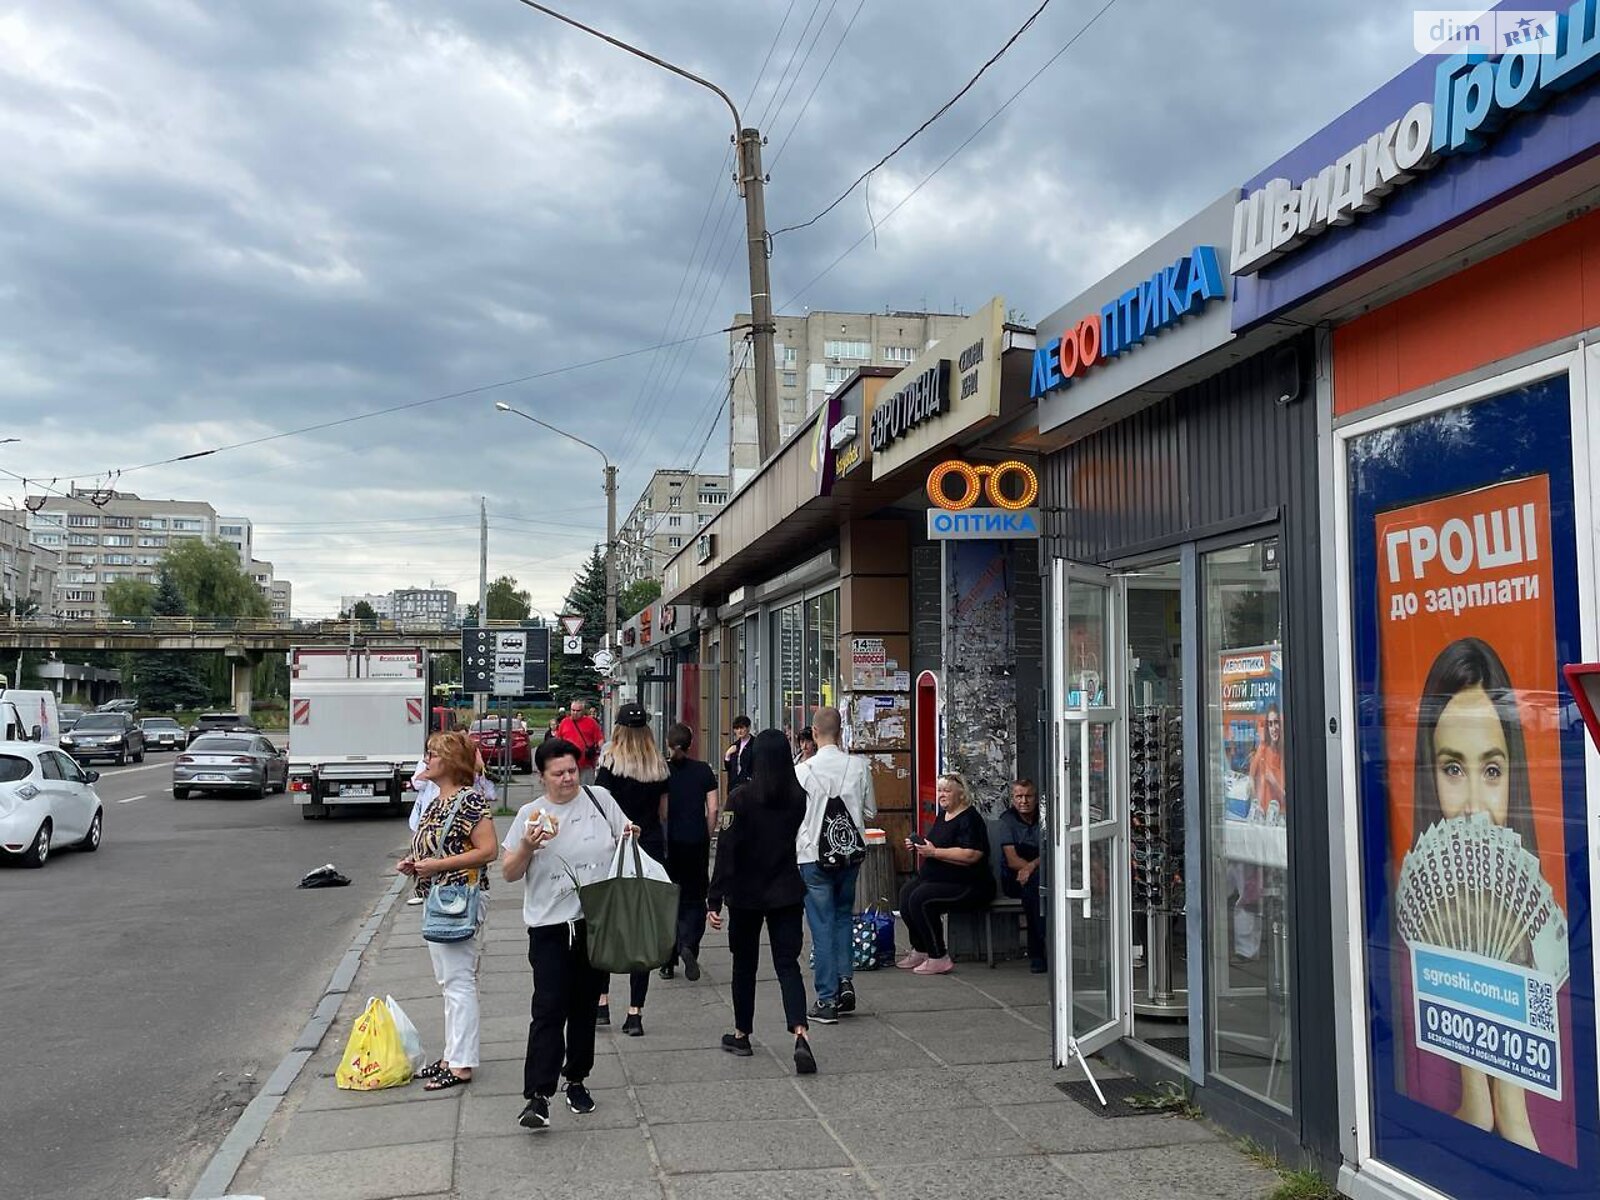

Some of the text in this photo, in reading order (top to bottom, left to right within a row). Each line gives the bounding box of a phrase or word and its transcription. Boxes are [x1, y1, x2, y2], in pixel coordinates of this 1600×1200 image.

[934, 514, 1037, 533] ОПТИКА
[1386, 503, 1539, 583] ГРОШІ
[1390, 574, 1540, 621] до зарплати
[854, 640, 868, 649] 14
[1529, 904, 1550, 940] 1000
[1423, 968, 1520, 1006] sgroshi.com.ua
[1427, 1006, 1550, 1070] 0 800 20 10 50
[1512, 1062, 1520, 1073] ТА
